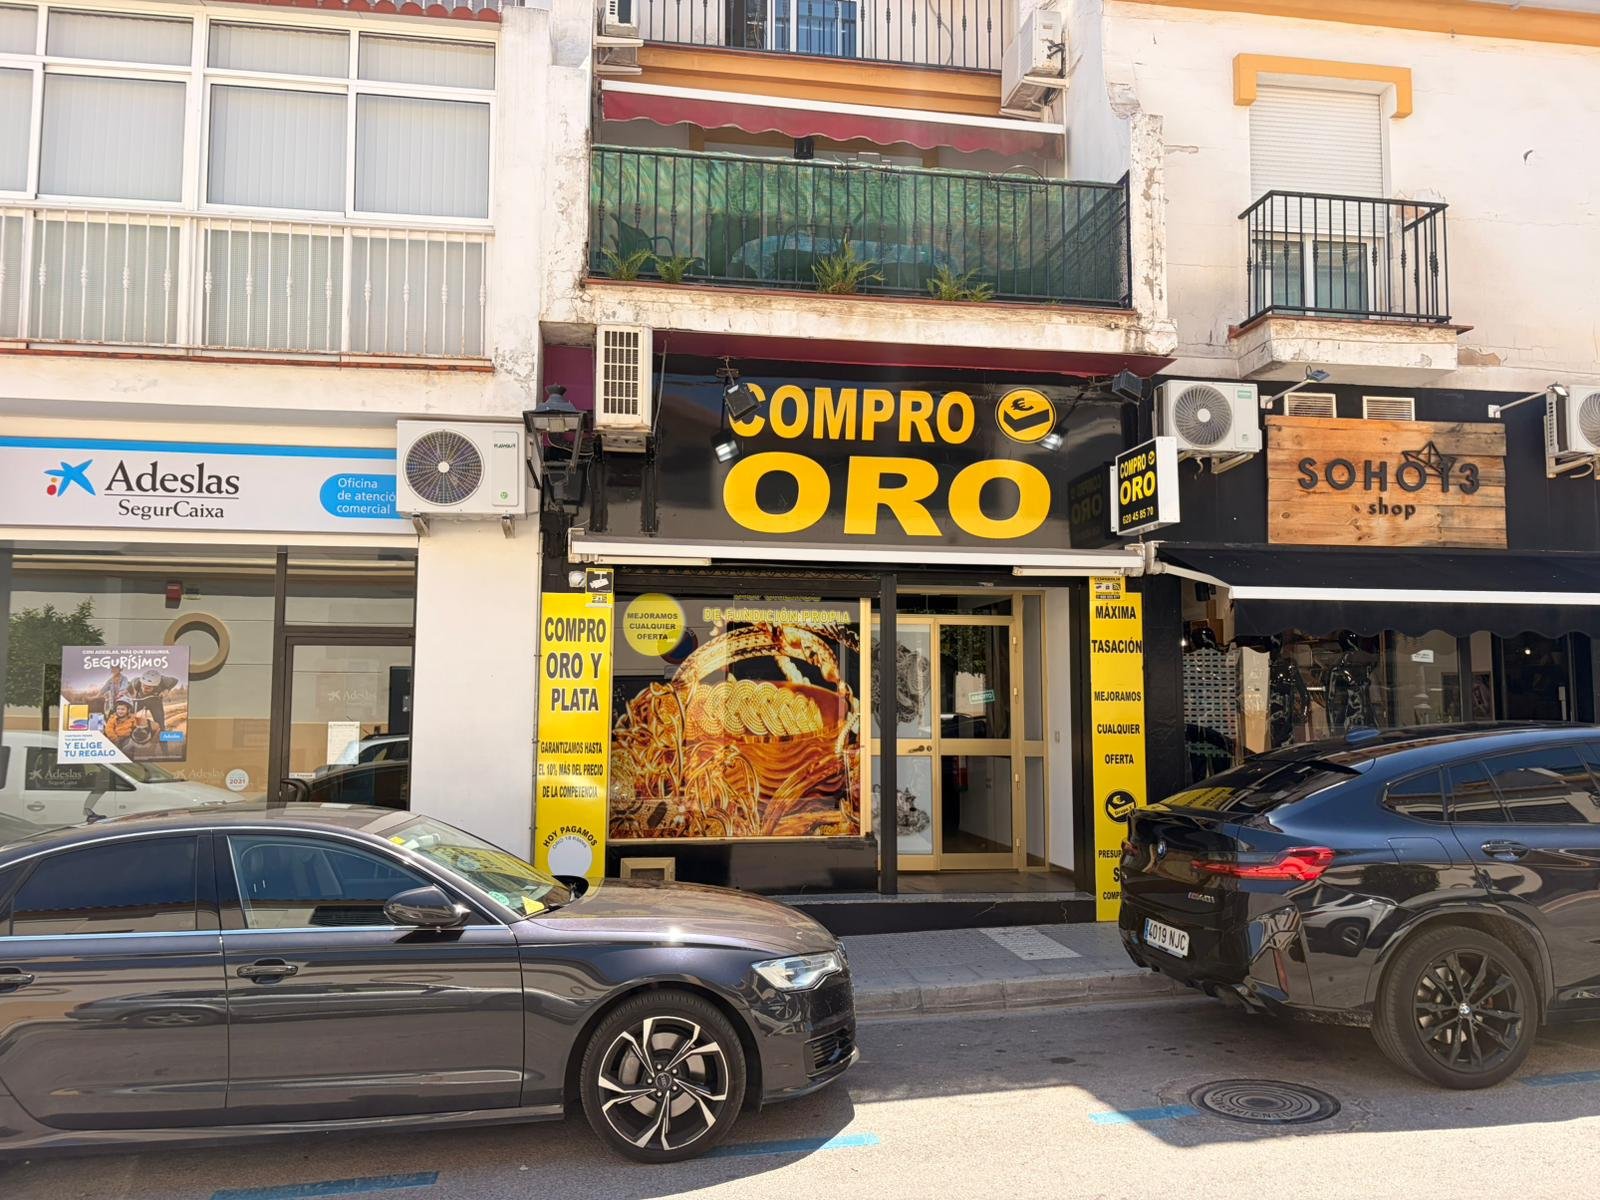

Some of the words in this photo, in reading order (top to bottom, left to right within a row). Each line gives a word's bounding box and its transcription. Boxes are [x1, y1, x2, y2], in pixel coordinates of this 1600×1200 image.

[729, 383, 975, 444] COMPRO
[1120, 453, 1146, 479] COMPRO
[104, 459, 240, 495] Adeslas
[338, 477, 378, 488] Oficina
[337, 490, 351, 500] de
[723, 451, 1051, 539] ORO
[1120, 471, 1156, 505] ORO
[118, 499, 225, 520] SegurCaixa
[336, 504, 391, 514] comercial
[1368, 497, 1416, 520] shop
[703, 608, 721, 621] DE
[725, 607, 799, 622] FUNDICIÓN
[802, 610, 851, 623] PROPIA
[1095, 603, 1136, 619] MÁXIMA
[545, 617, 607, 643] COMPRO
[1092, 637, 1142, 653] TASACIÓN
[83, 655, 169, 669] SEGURÍSIMOS
[546, 652, 583, 679] ORO
[591, 653, 602, 678] Y
[551, 688, 599, 711] PLATA
[1094, 691, 1142, 701] MEJORAMOS
[1097, 723, 1140, 734] CUALQUIER
[540, 742, 583, 754] GARANTIZAMOS
[585, 742, 603, 754] HASTA
[1104, 754, 1134, 765] OFERTA
[538, 764, 545, 775] EL
[571, 764, 582, 775] DEL
[583, 764, 604, 776] PRECIO
[543, 786, 550, 797] DE
[551, 786, 558, 797] LA
[559, 786, 598, 798] COMPETENCIA
[543, 830, 558, 847] HOY
[560, 825, 598, 846] PAGAMOS
[1149, 922, 1167, 943] 4019
[1169, 930, 1187, 951] NJC
